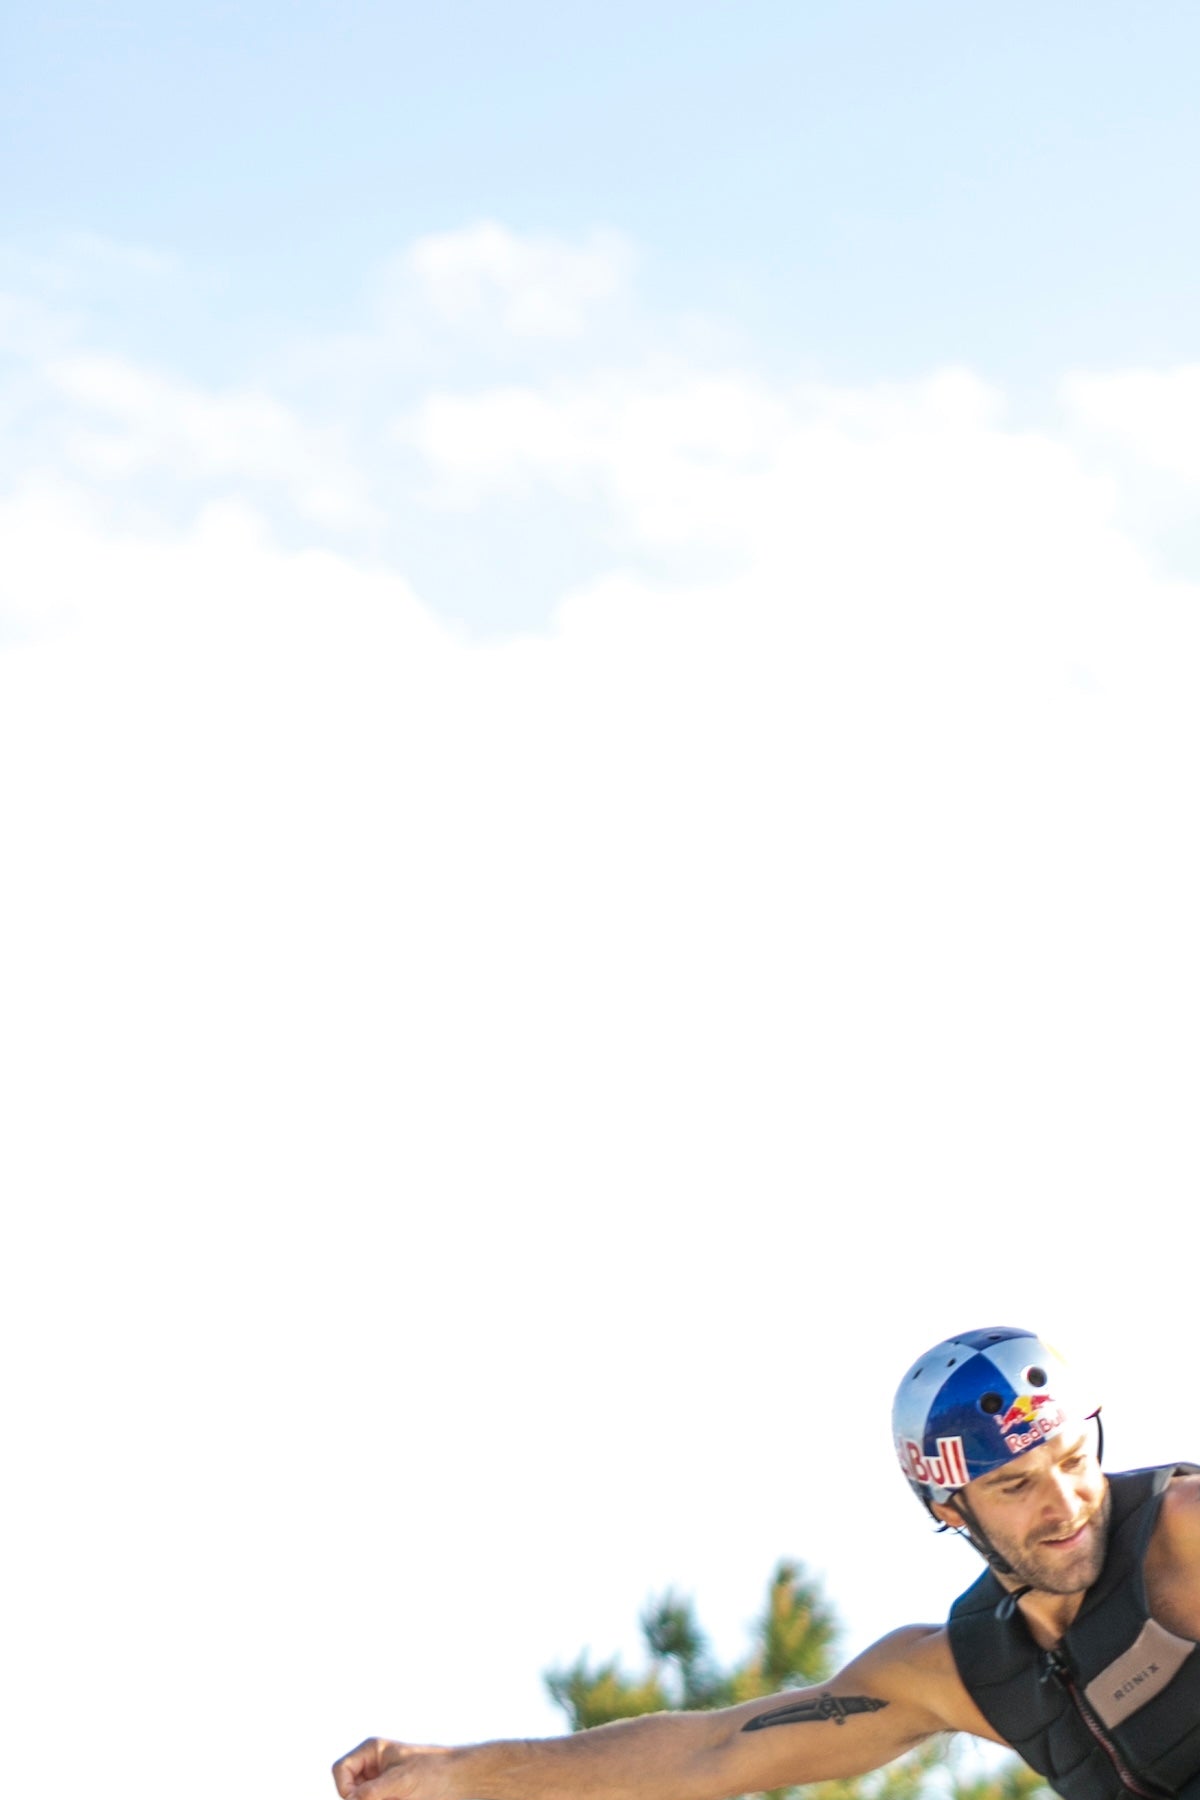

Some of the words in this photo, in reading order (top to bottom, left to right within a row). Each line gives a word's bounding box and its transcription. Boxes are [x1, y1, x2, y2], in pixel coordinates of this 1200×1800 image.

[1005, 1421, 1042, 1453] Red
[905, 1437, 969, 1486] Bull
[1113, 1663, 1159, 1700] RONIX
